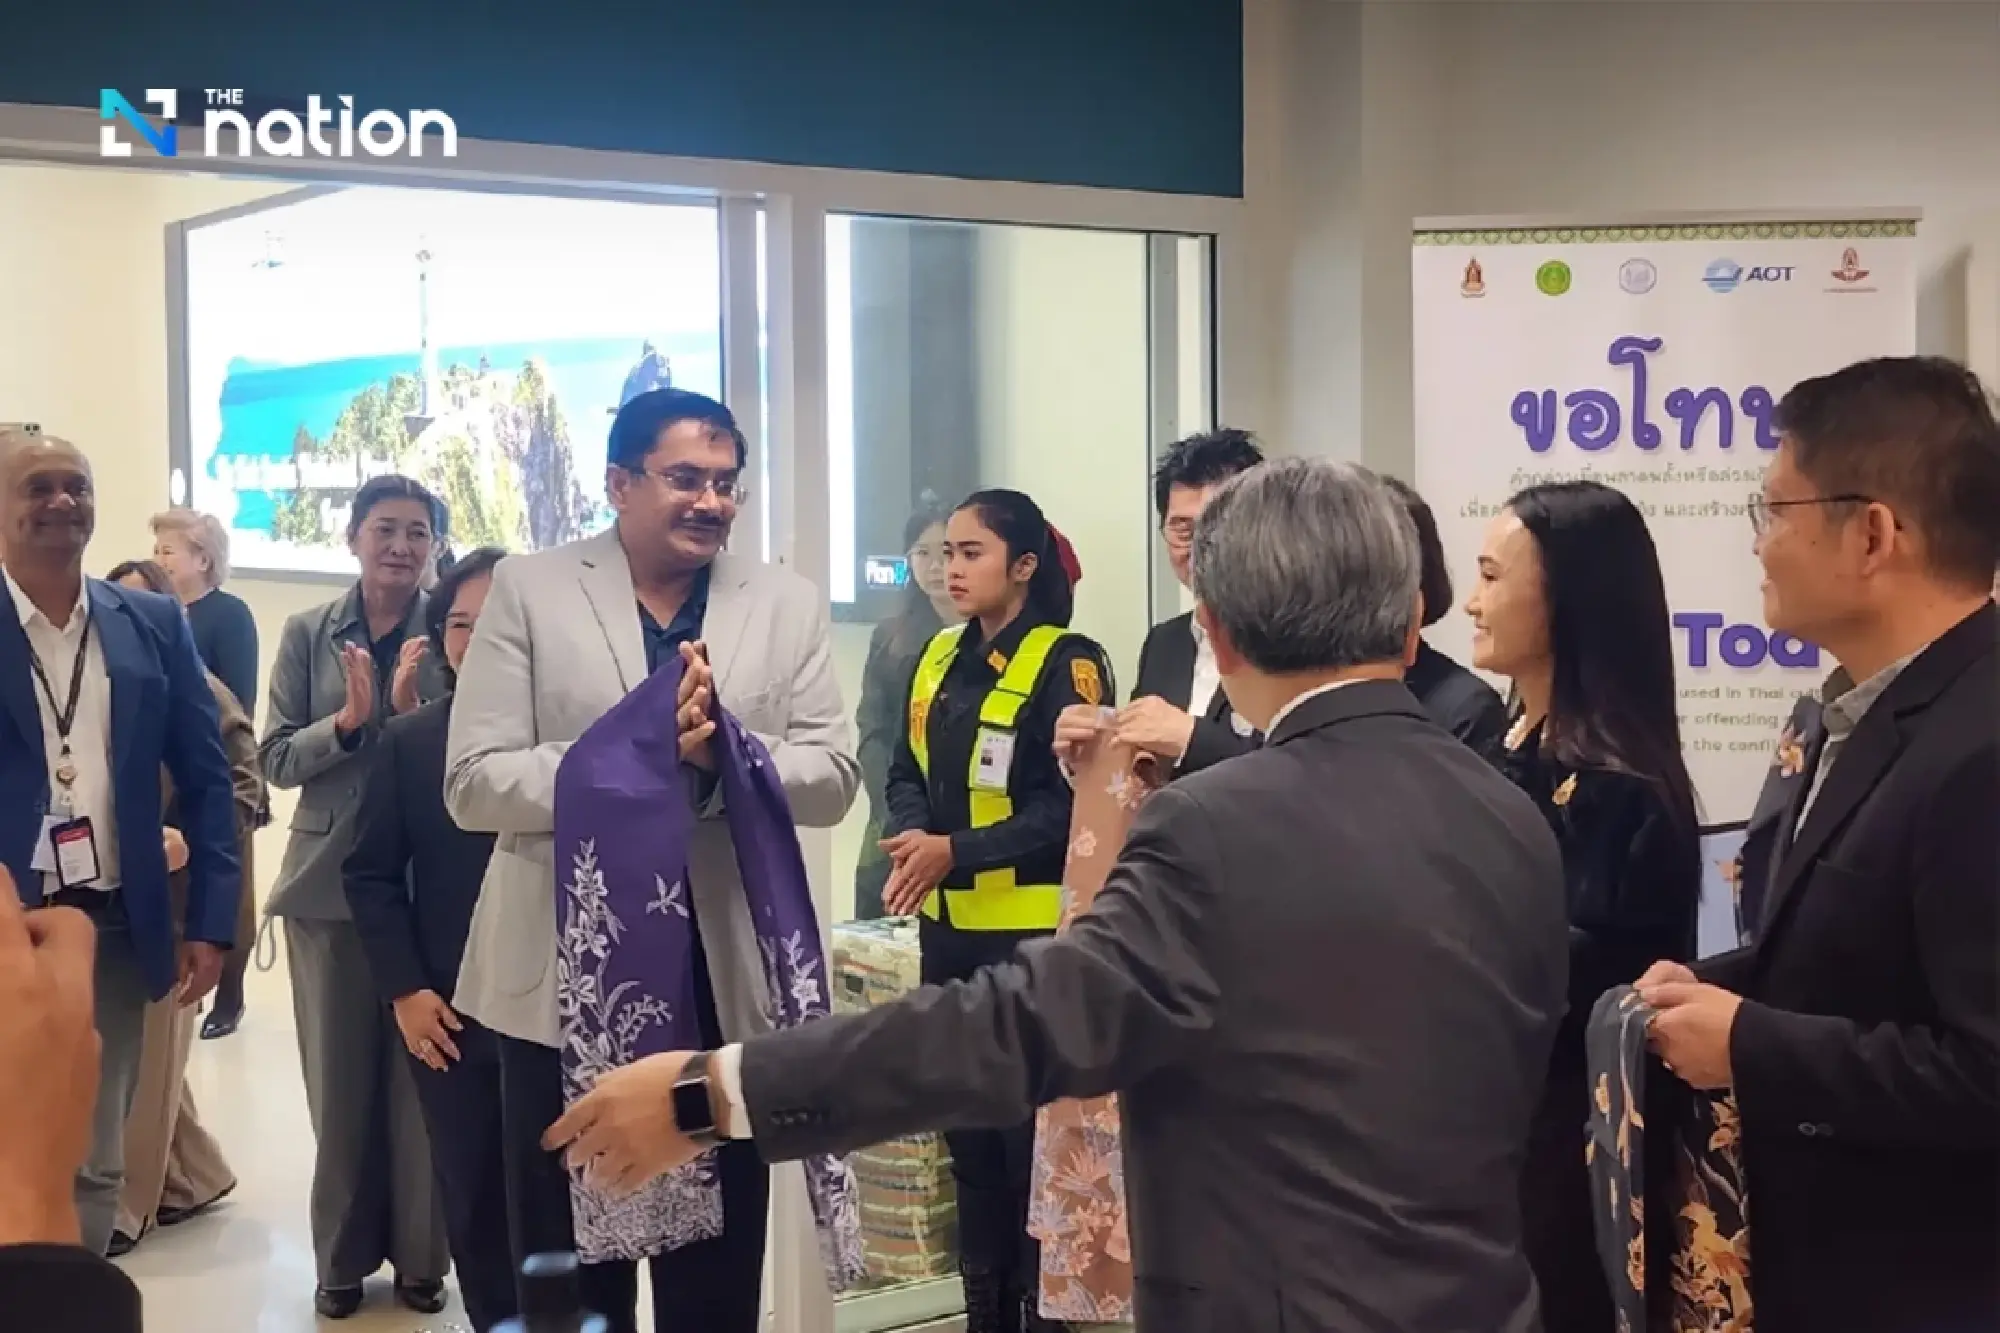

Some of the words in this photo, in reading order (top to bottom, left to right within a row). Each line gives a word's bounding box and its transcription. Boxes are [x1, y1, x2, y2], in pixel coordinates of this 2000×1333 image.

[1746, 267, 1795, 281] AOT
[1680, 687, 1720, 699] used
[1726, 686, 1741, 699] in
[1748, 686, 1784, 699] Thai
[1695, 712, 1778, 728] offending
[1693, 738, 1722, 751] the
